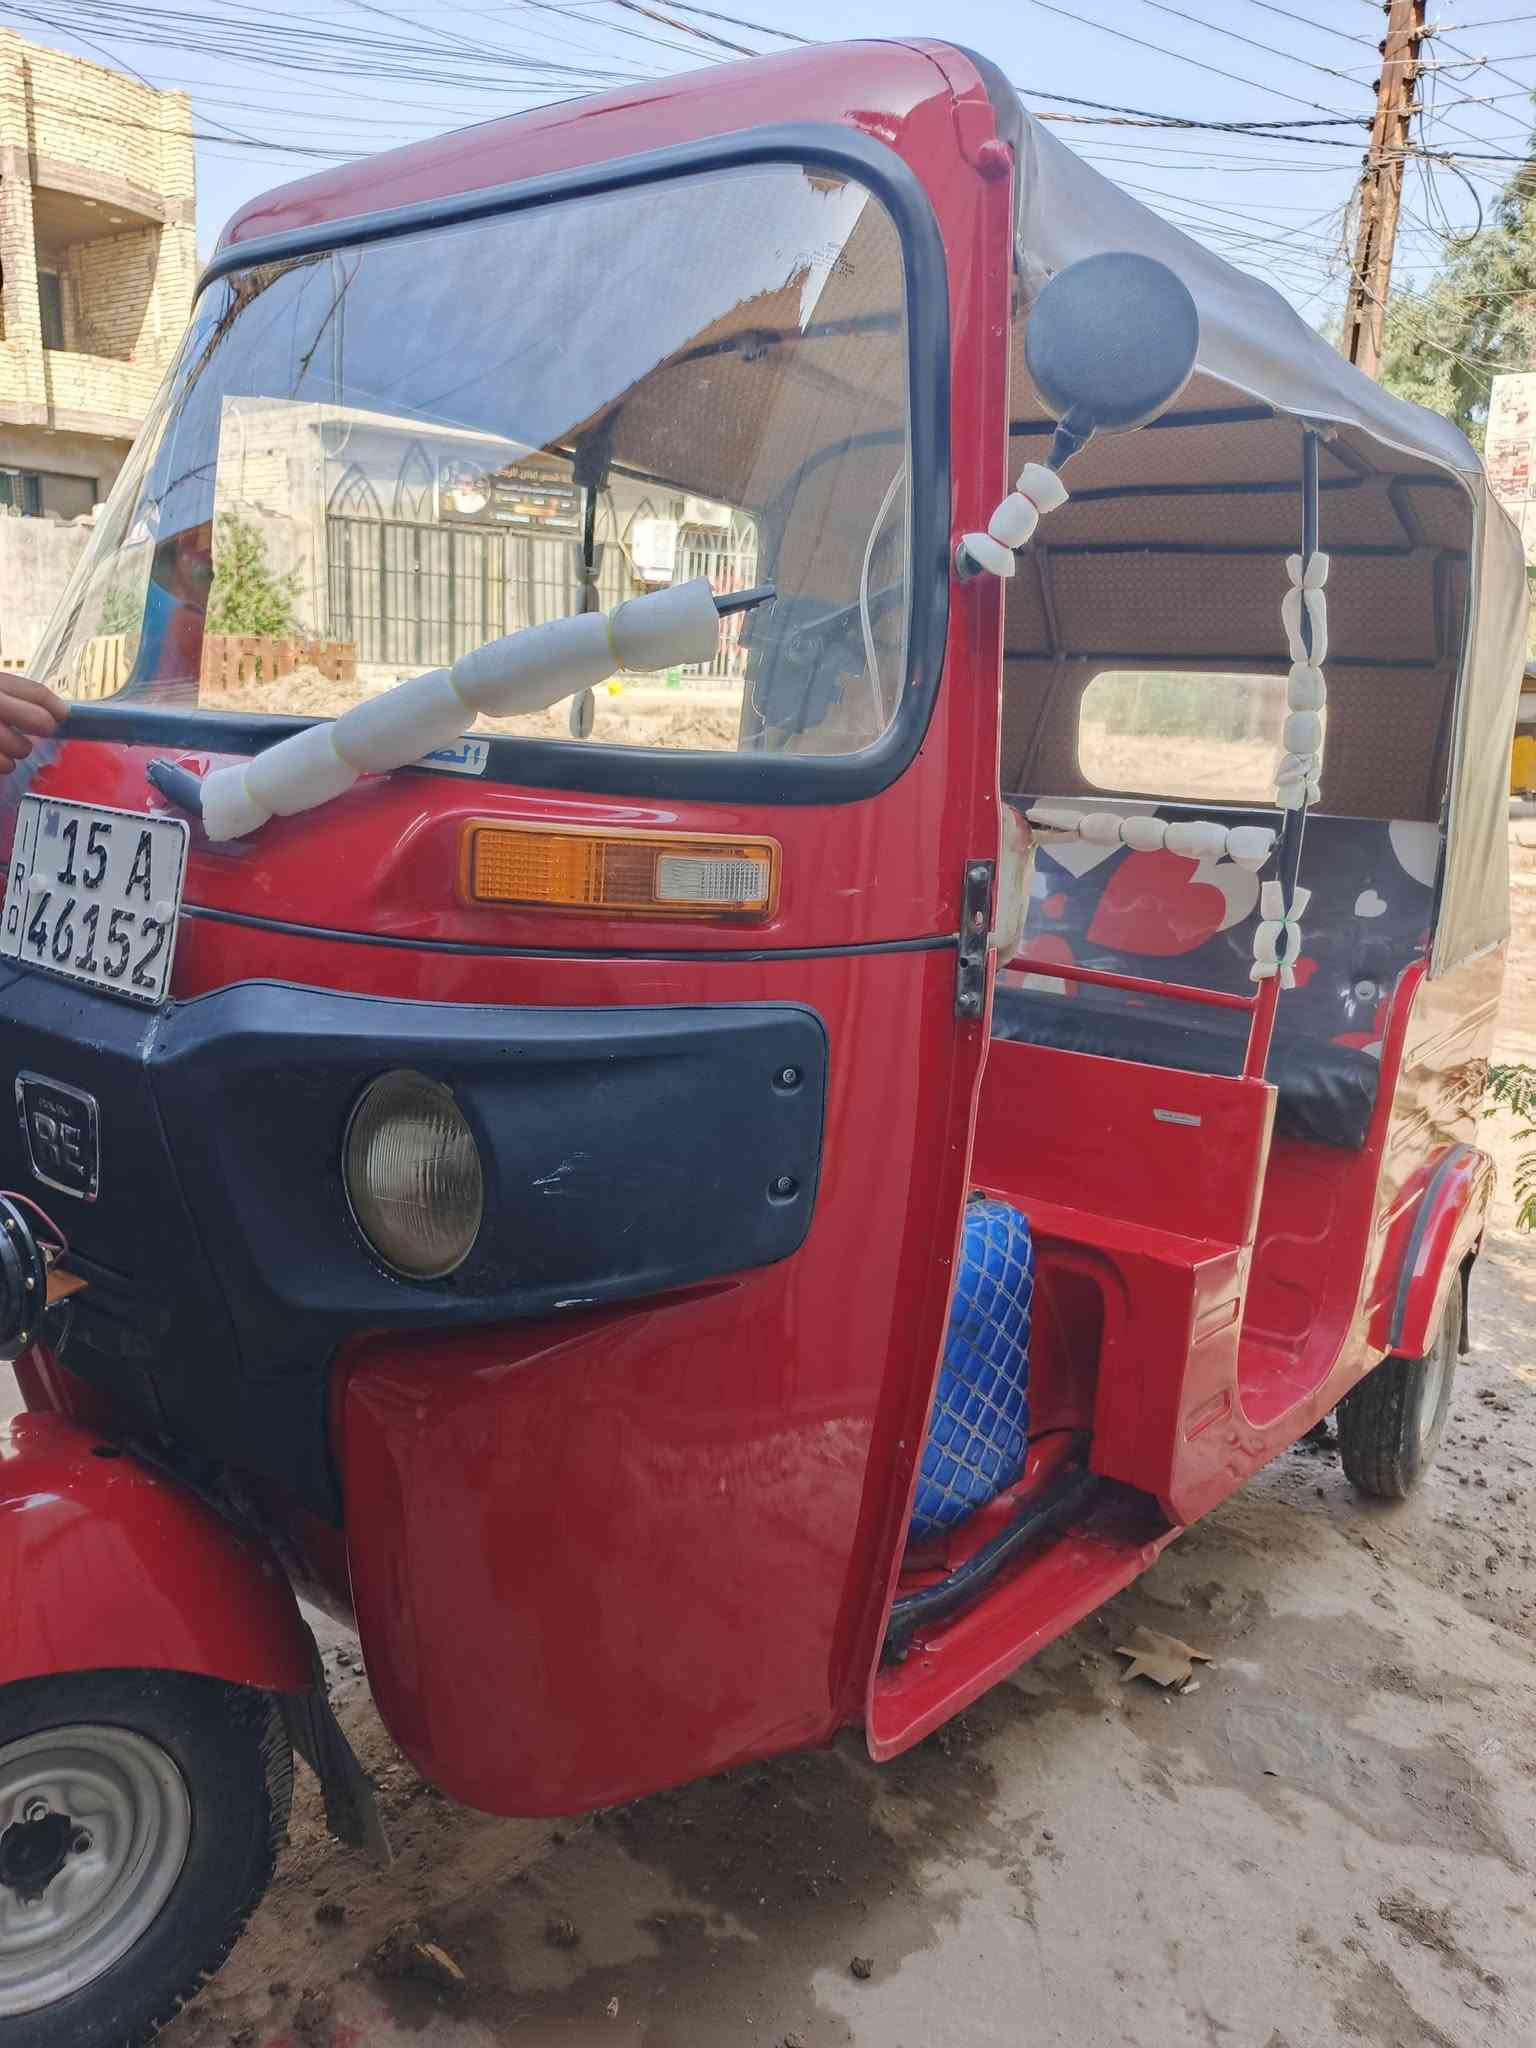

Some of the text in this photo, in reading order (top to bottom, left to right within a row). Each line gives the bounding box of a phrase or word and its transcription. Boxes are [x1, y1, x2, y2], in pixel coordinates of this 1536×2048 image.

[57, 818, 152, 901] 15 A
[28, 892, 166, 988] 46152
